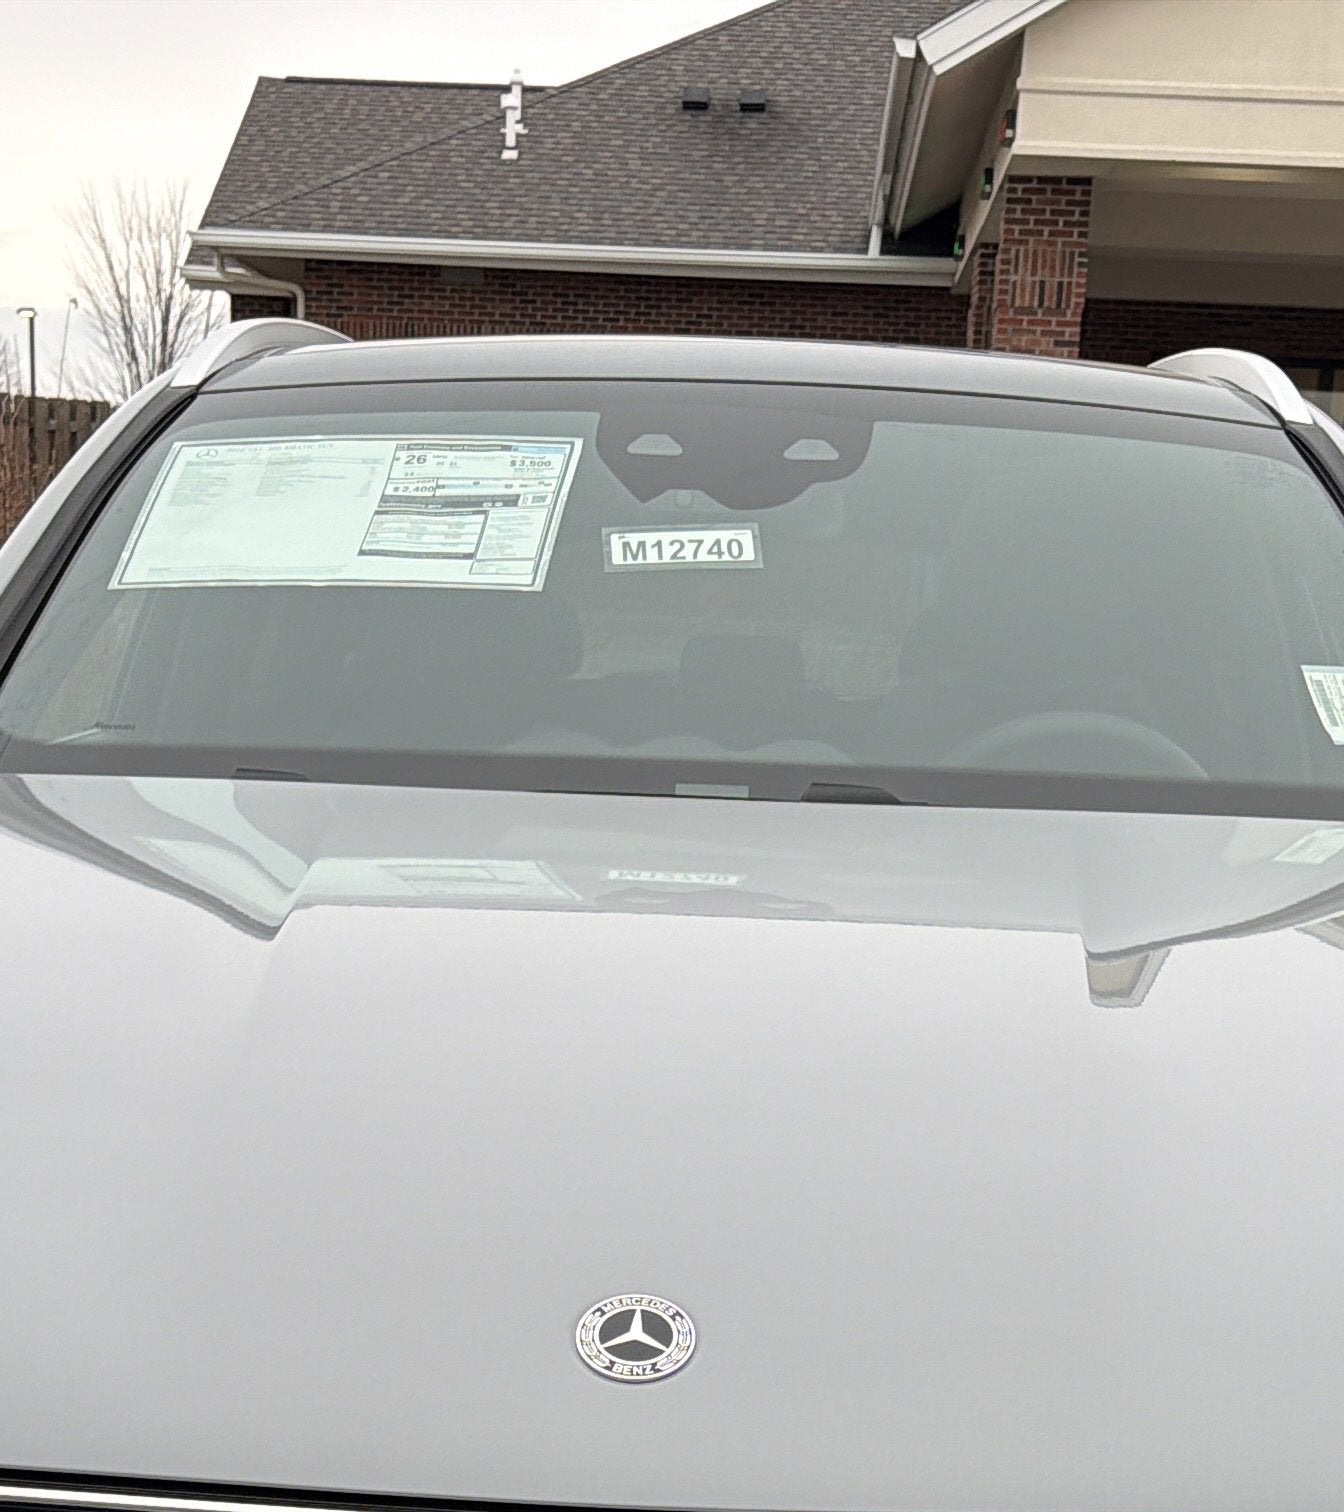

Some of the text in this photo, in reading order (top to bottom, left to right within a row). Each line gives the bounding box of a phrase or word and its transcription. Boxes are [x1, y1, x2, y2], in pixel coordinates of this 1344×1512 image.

[404, 454, 428, 465] 26
[621, 537, 744, 562] M12740
[601, 1296, 677, 1317] MERCEDES
[611, 1362, 655, 1376] BENZ
